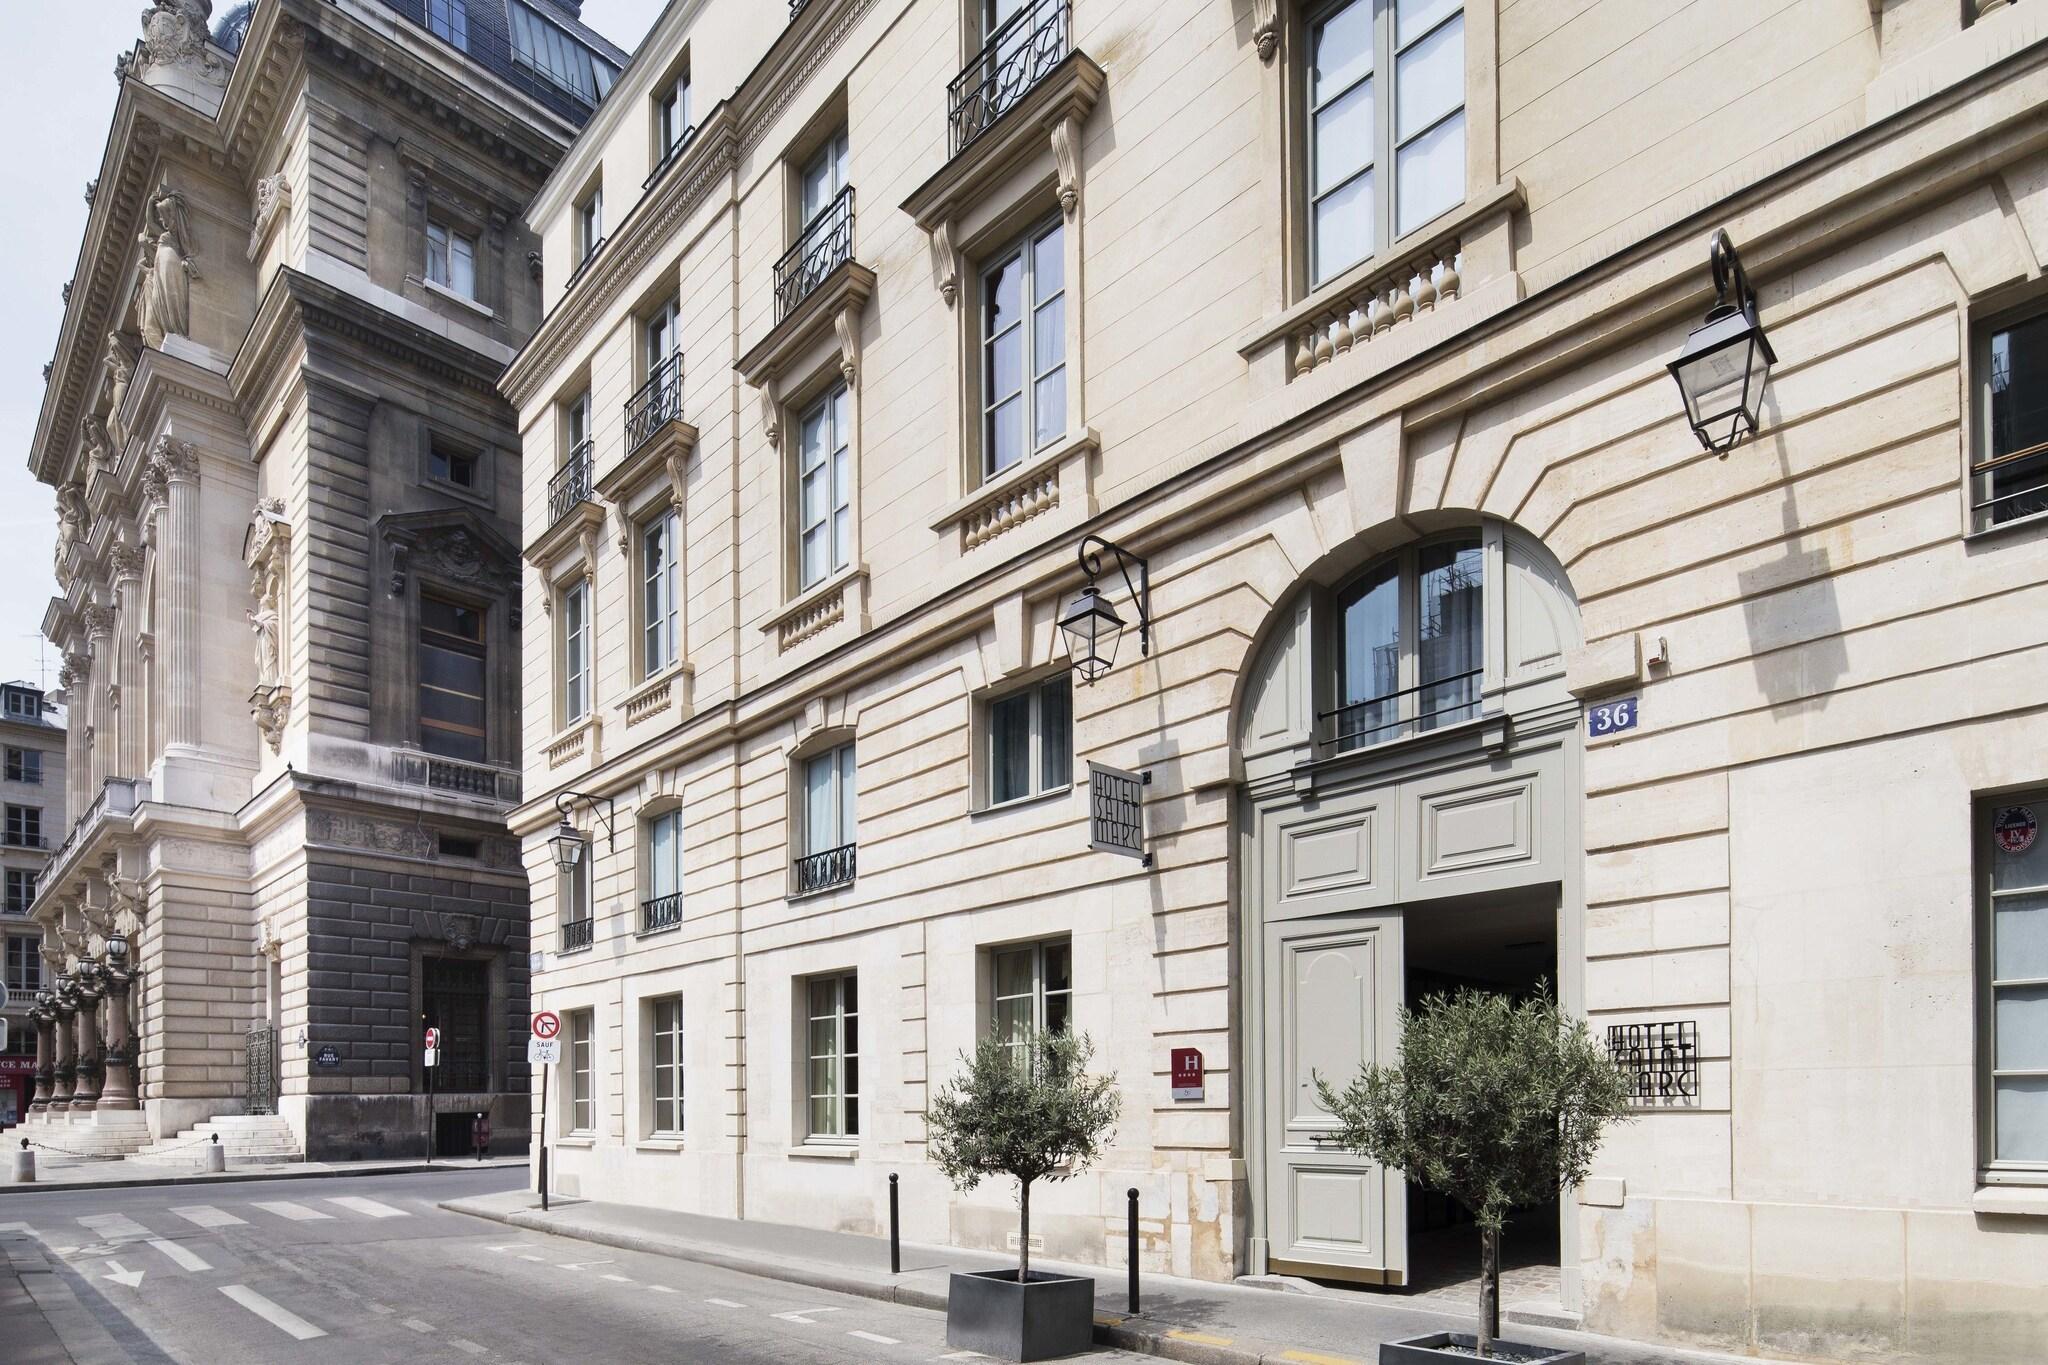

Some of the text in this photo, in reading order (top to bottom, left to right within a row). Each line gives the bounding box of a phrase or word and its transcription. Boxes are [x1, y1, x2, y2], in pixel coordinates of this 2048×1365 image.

[1597, 703, 1629, 730] 36
[1095, 771, 1139, 807] HOTEL
[1096, 819, 1141, 850] MARC
[1612, 1022, 1691, 1050] HOTEL
[1185, 1055, 1198, 1070] H
[1629, 1071, 1690, 1097] ARC
